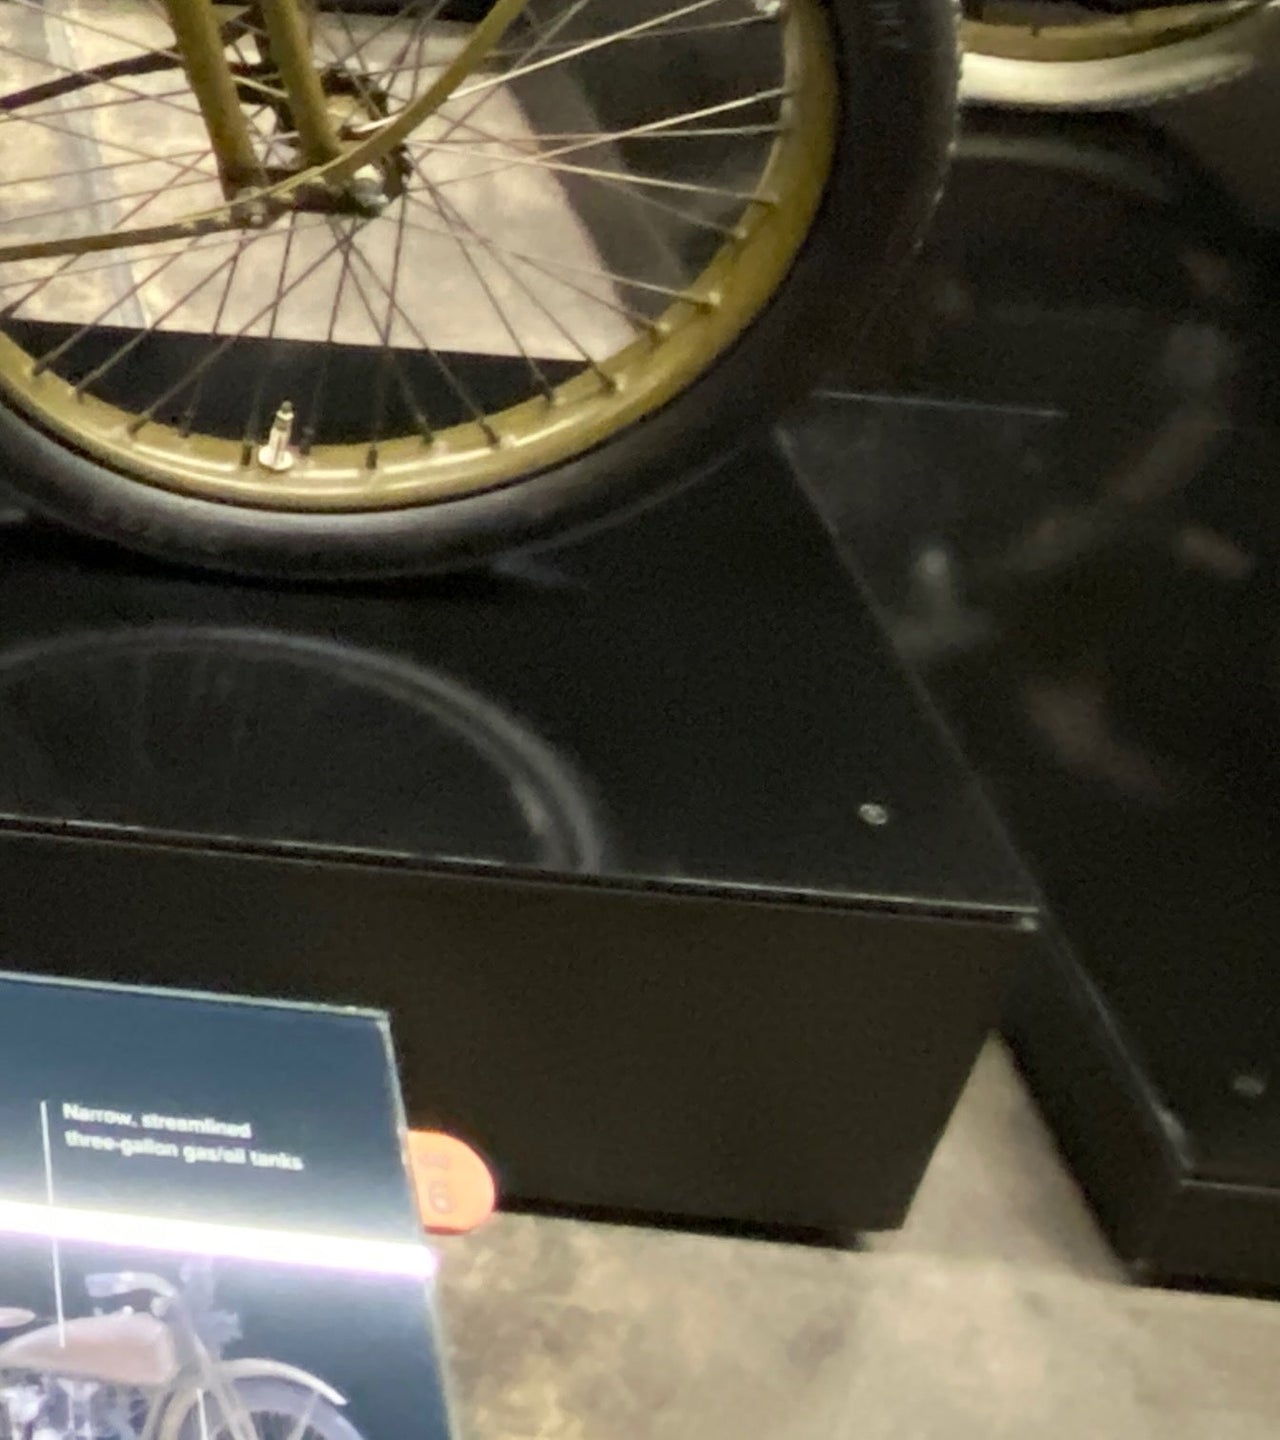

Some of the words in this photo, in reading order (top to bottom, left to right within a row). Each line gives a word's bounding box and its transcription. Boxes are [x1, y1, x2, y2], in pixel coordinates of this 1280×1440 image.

[142, 1113, 252, 1139] streamlined
[64, 1130, 179, 1157] three-gallon
[182, 1145, 247, 1164] gas/oil
[249, 1149, 305, 1171] tanks
